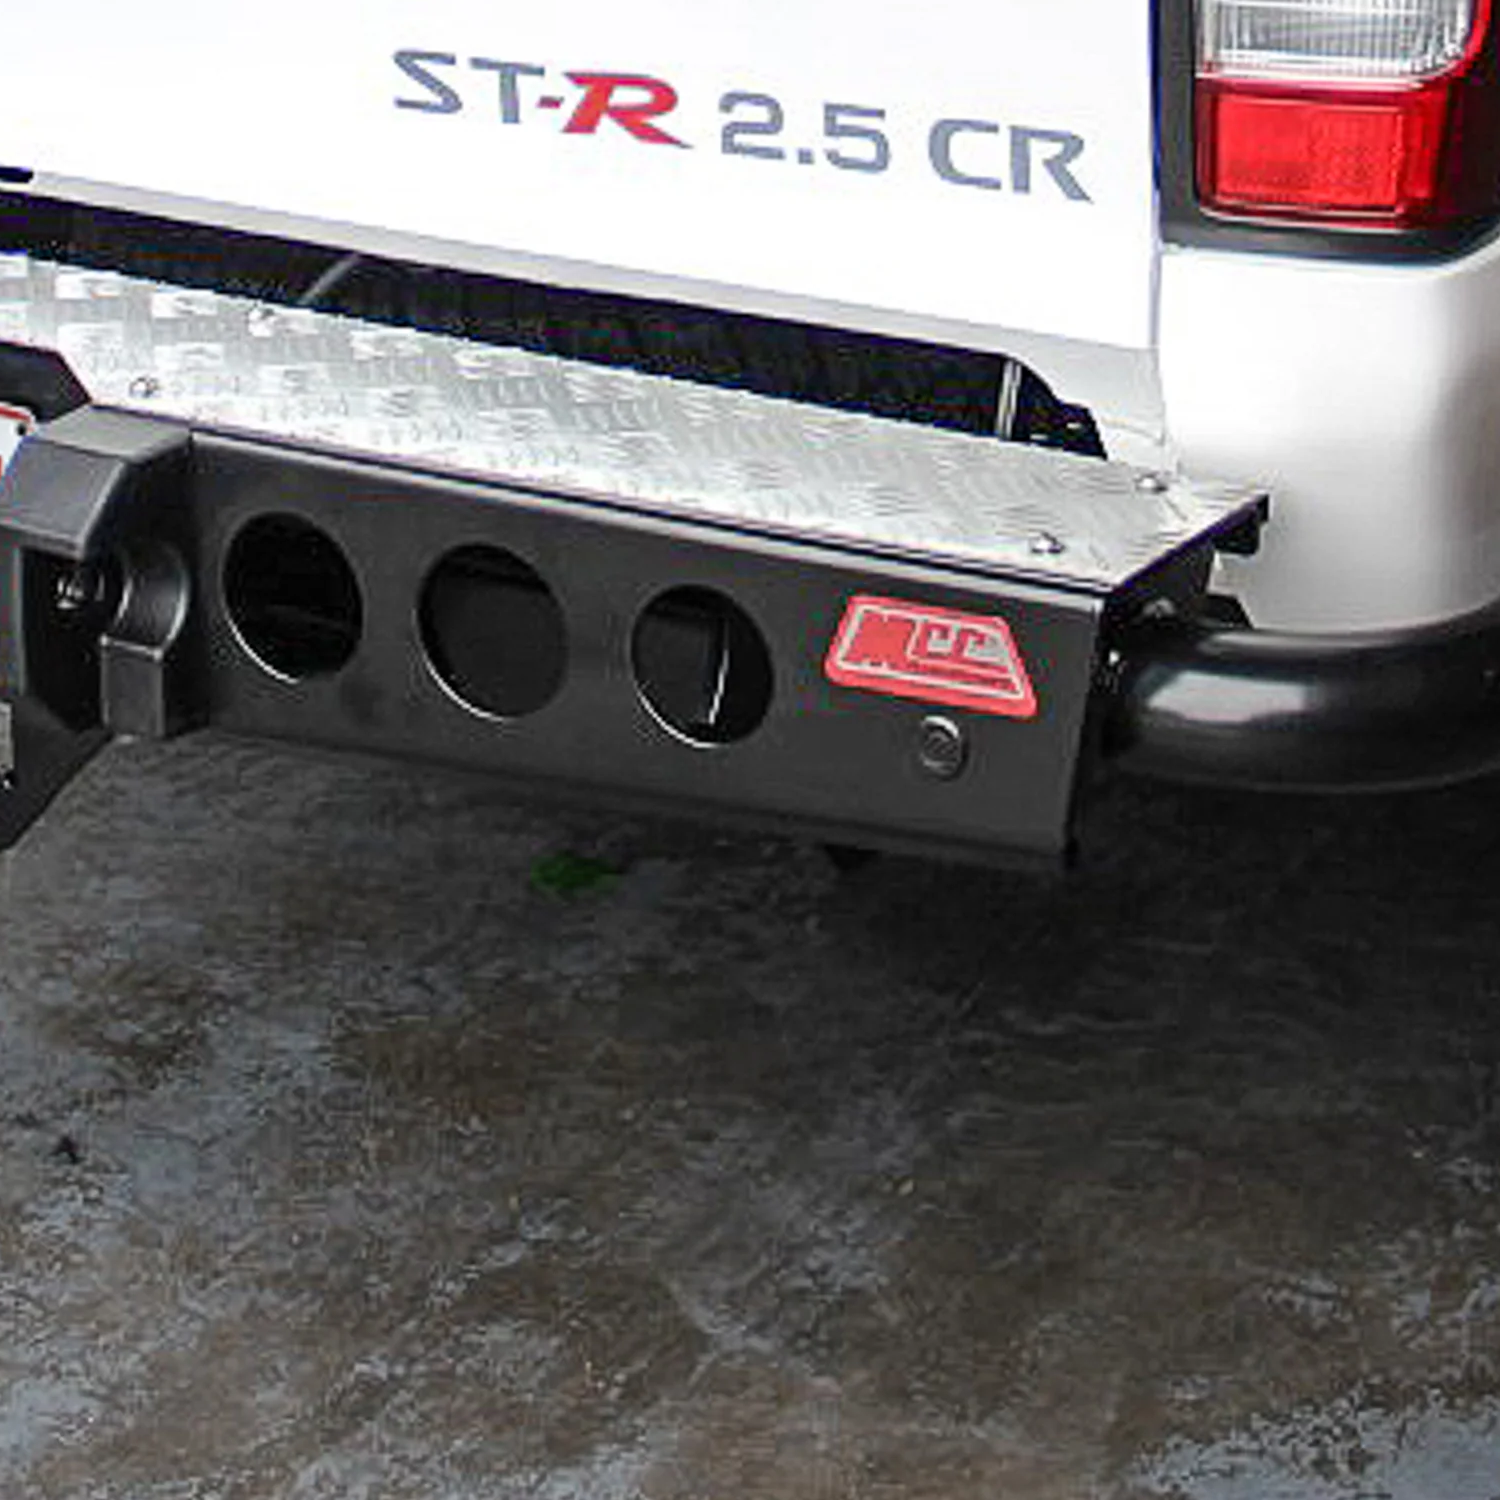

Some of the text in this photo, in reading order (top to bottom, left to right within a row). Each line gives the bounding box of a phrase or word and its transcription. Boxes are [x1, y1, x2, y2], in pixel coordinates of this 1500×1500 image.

[392, 48, 1094, 204] ST-R 2.5 CR
